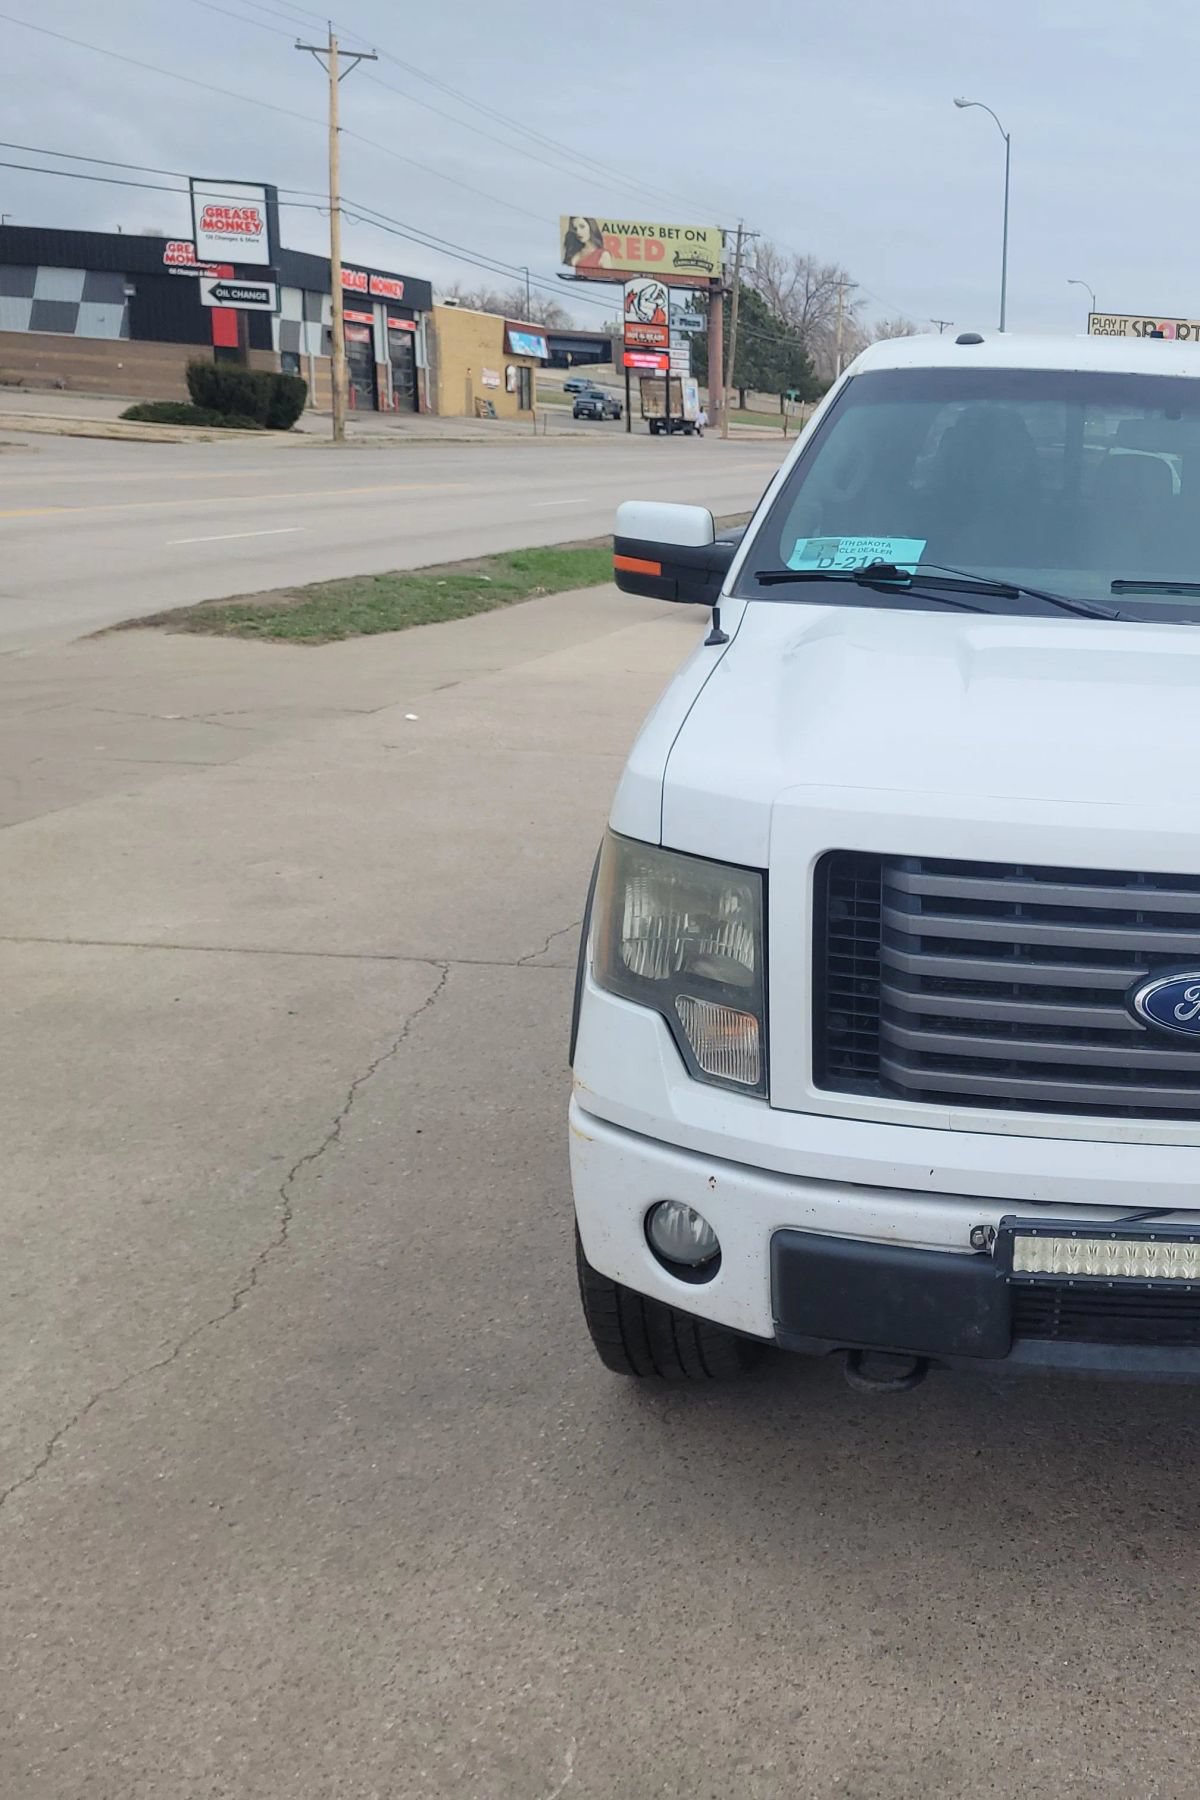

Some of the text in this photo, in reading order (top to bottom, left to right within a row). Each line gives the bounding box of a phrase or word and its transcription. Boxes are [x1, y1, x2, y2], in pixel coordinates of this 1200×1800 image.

[205, 207, 257, 221] GREASE
[202, 219, 262, 233] MONKEY
[602, 223, 707, 242] ALWAYS BET ON
[168, 243, 192, 253] GRE
[604, 236, 666, 262] RED
[341, 271, 367, 293] REASE
[215, 288, 267, 300] OIL CHANGE
[1092, 318, 1129, 330] PLAY IT
